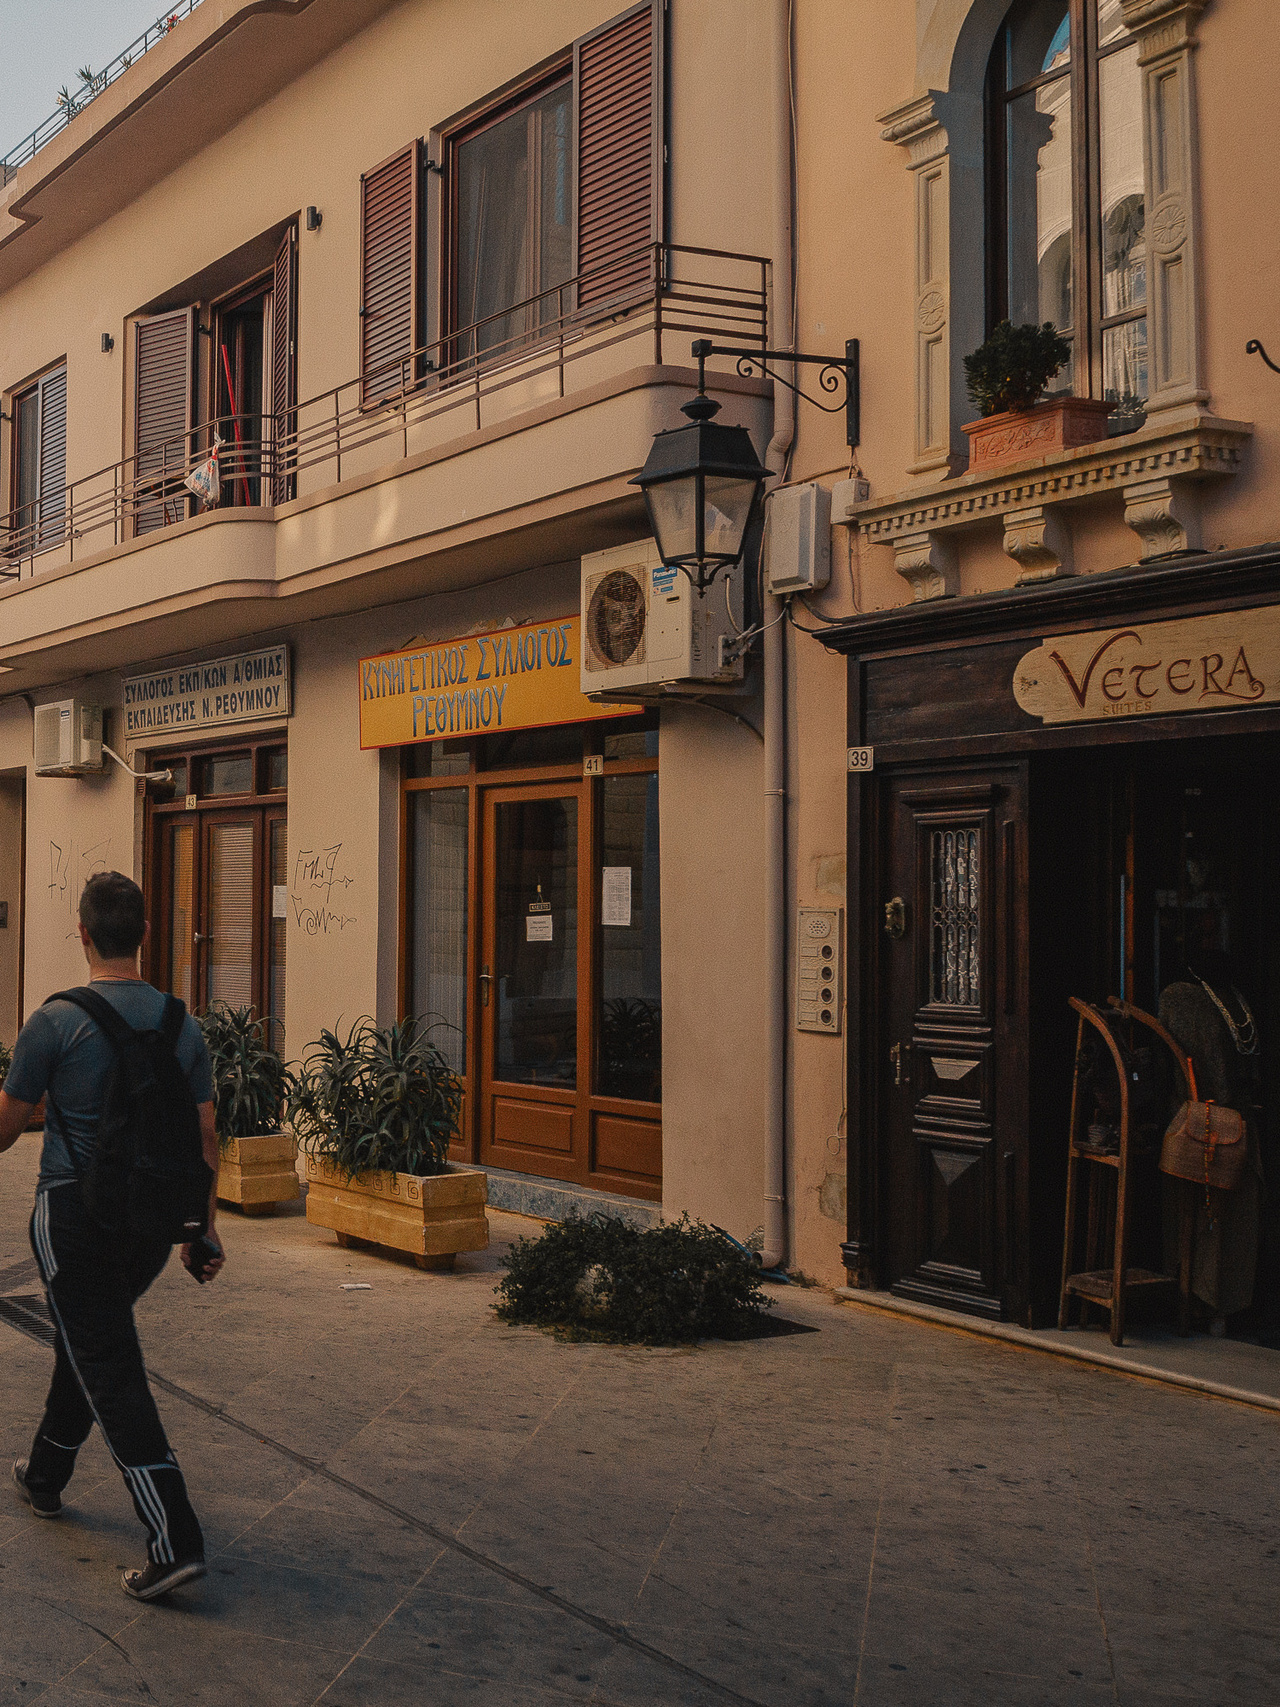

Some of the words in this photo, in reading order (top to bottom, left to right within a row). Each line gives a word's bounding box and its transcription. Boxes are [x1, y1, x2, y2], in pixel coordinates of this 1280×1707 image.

[125, 676, 174, 704] ΣΥΛΛΟΓΟΣ
[179, 666, 227, 694] ΕΚΠ/ΚΩΝ
[233, 654, 283, 685] Α/ΘΜΙΑΣ
[363, 644, 469, 700] ΚΥΝΗΓΕΤΙΚΟΣ
[476, 624, 572, 681] ΣΥΛΛΟΓΟΣ
[127, 700, 196, 730] ΕΚΠΑΙΔΕΥΣΗΣ
[216, 685, 280, 716] ΡΕΘΥΜΝΟΥ
[413, 683, 509, 737] ΡΕΘΥΜΝΟΥ
[1102, 701, 1152, 716] SUITES
[586, 758, 599, 772] 41
[851, 751, 868, 766] 39
